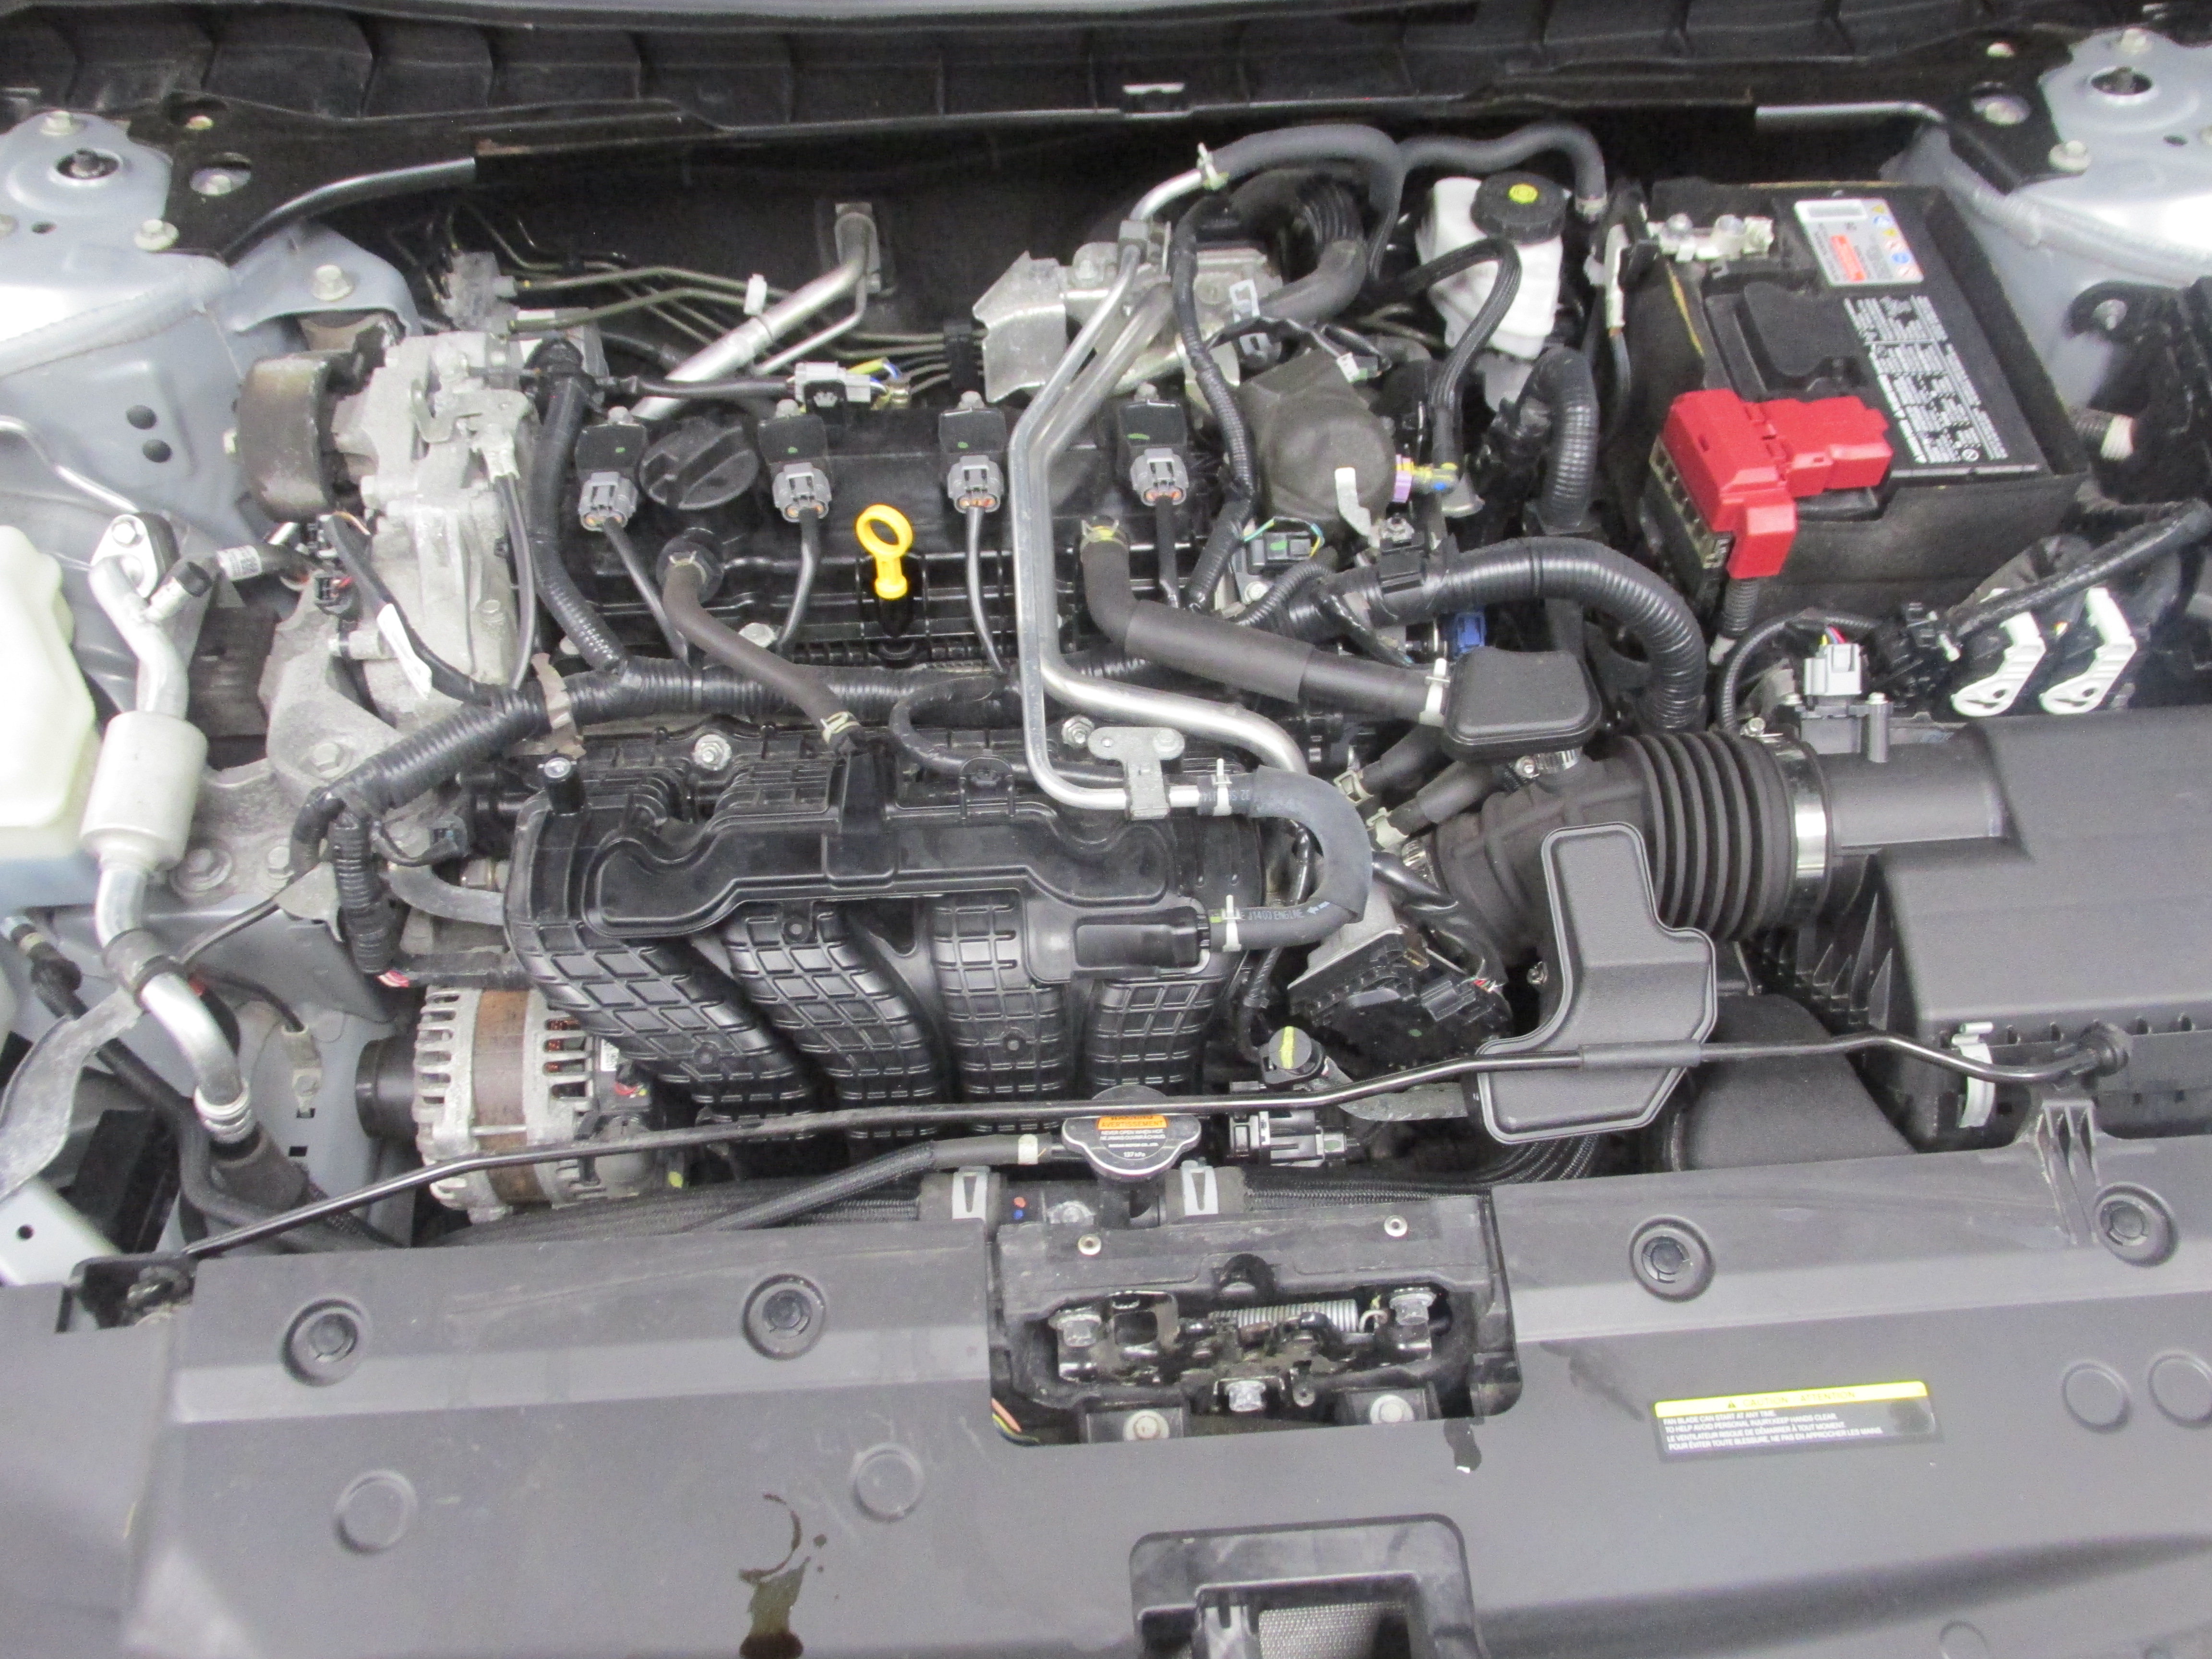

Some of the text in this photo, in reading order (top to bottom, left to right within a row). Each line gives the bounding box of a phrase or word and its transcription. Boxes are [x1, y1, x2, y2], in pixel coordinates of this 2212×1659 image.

[1743, 1396, 1788, 1407] CAUTION
[1801, 1391, 1856, 1402] ATTENTION
[1714, 1421, 1750, 1429] PERSONAL
[1676, 1432, 1719, 1441] VENTILATEUR
[1719, 1430, 1744, 1438] RISQUE
[1805, 1430, 1847, 1439] APPROCHER
